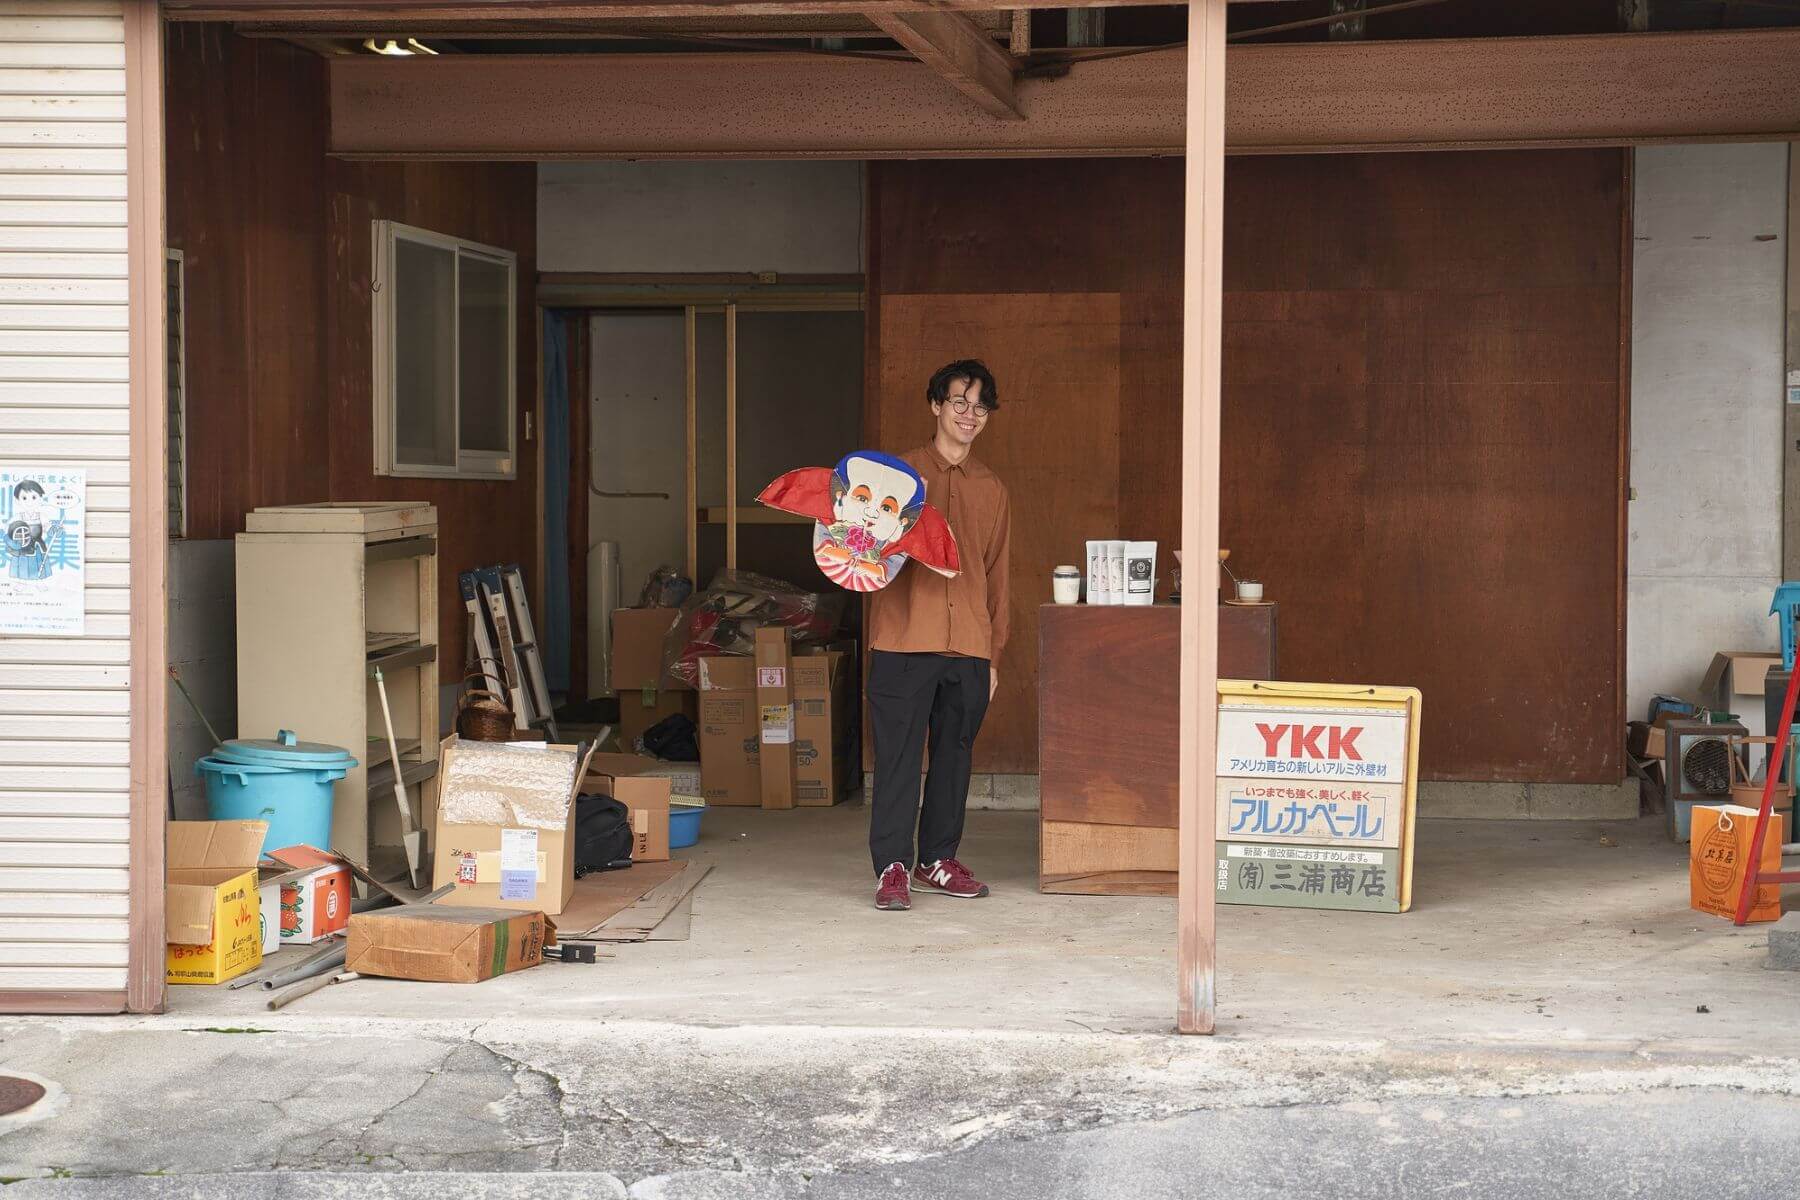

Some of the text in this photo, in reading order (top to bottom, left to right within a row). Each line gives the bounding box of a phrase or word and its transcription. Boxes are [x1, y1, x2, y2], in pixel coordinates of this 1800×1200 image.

[1255, 723, 1364, 760] YKK
[1230, 759, 1387, 777] アメリカ育ちの新しいアルミ外壁材
[1245, 787, 1370, 801] いつまでも強く、美しく、軽く
[1230, 798, 1382, 838] アルカベール
[933, 869, 952, 886] N
[1217, 859, 1229, 891] 取扱店
